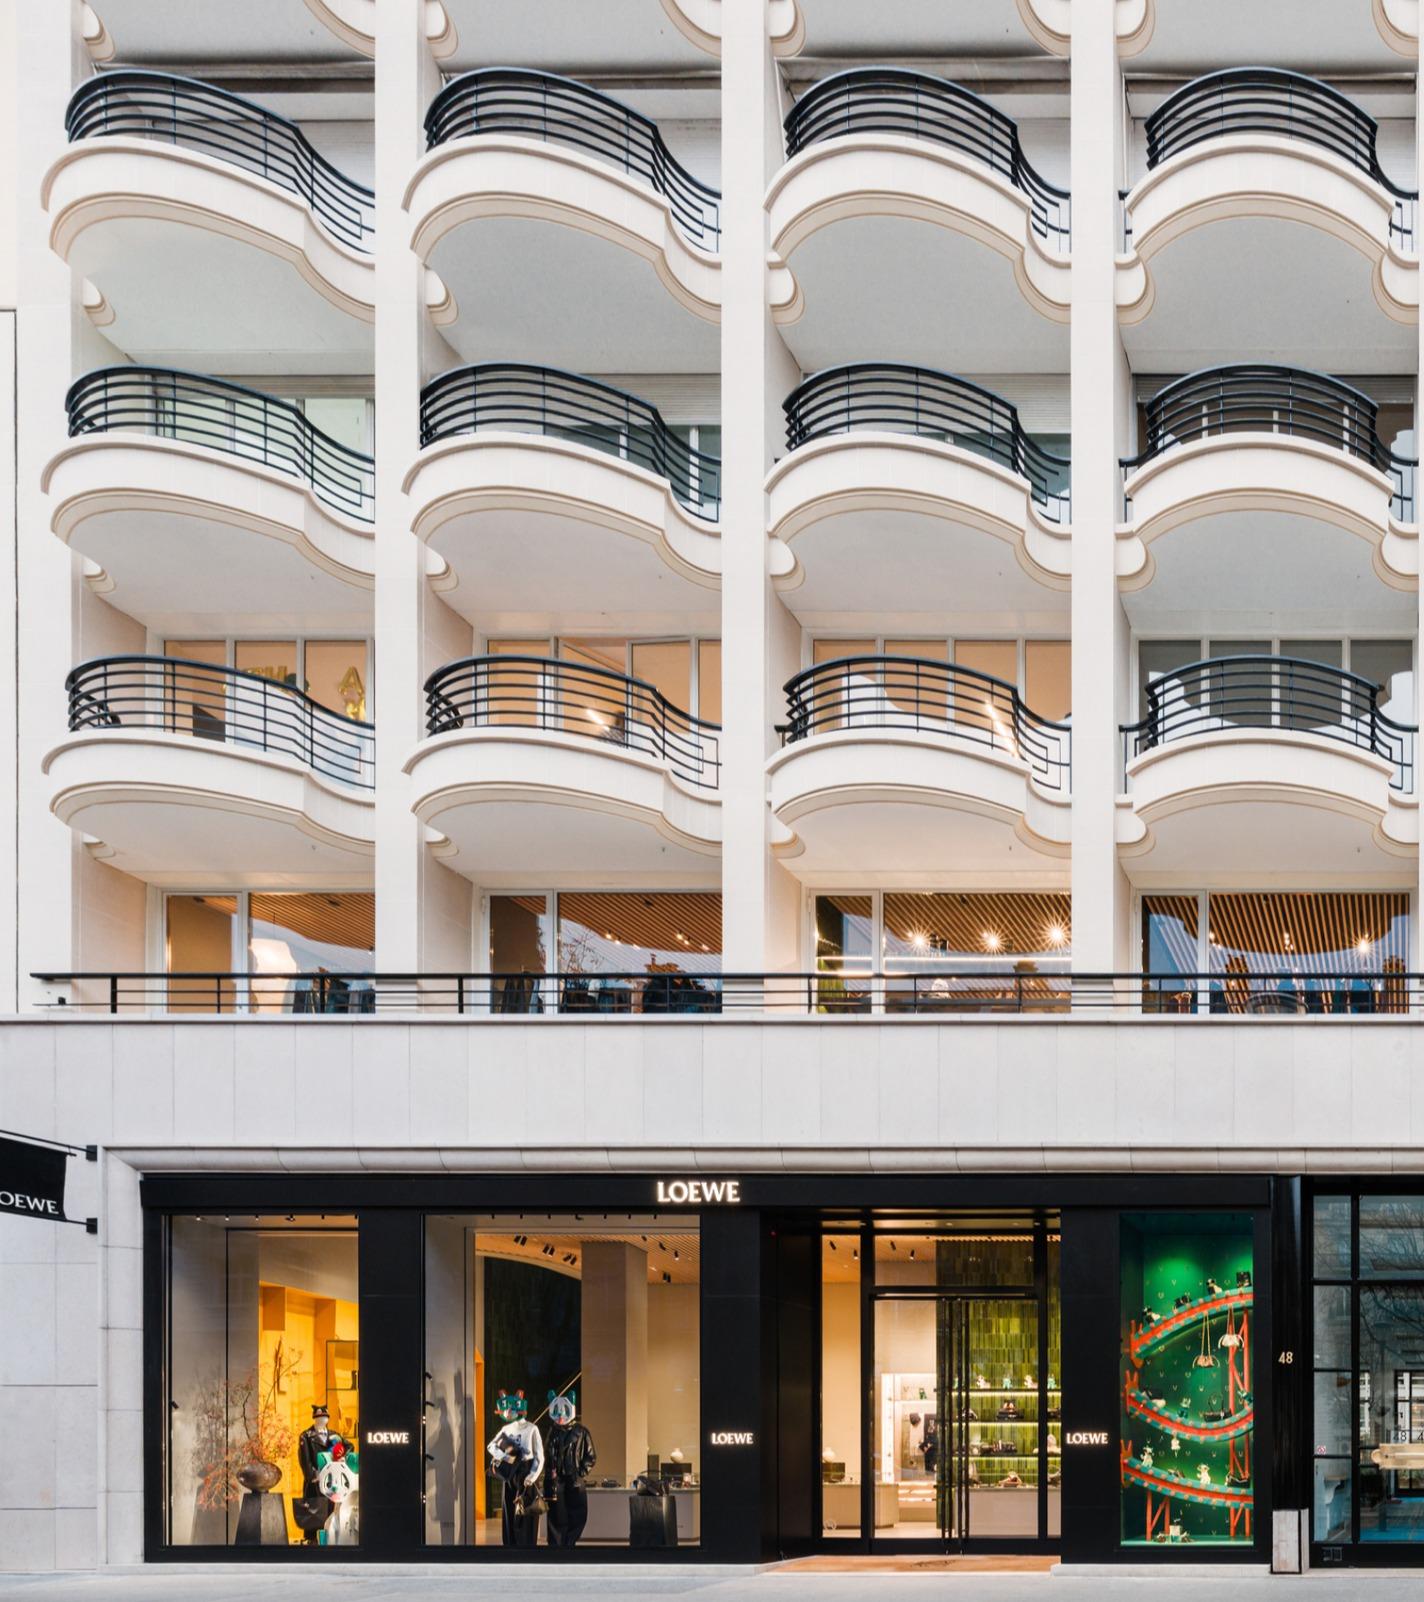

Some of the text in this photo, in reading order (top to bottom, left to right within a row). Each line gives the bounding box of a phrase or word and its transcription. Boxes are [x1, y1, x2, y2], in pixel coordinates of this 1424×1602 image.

[656, 1181, 742, 1205] LOEWE
[0, 1190, 59, 1215] OEWE
[1278, 1351, 1294, 1364] 48
[366, 1431, 410, 1445] LOEWE
[711, 1431, 754, 1445] LOEWE
[1065, 1431, 1109, 1445] LOEWE
